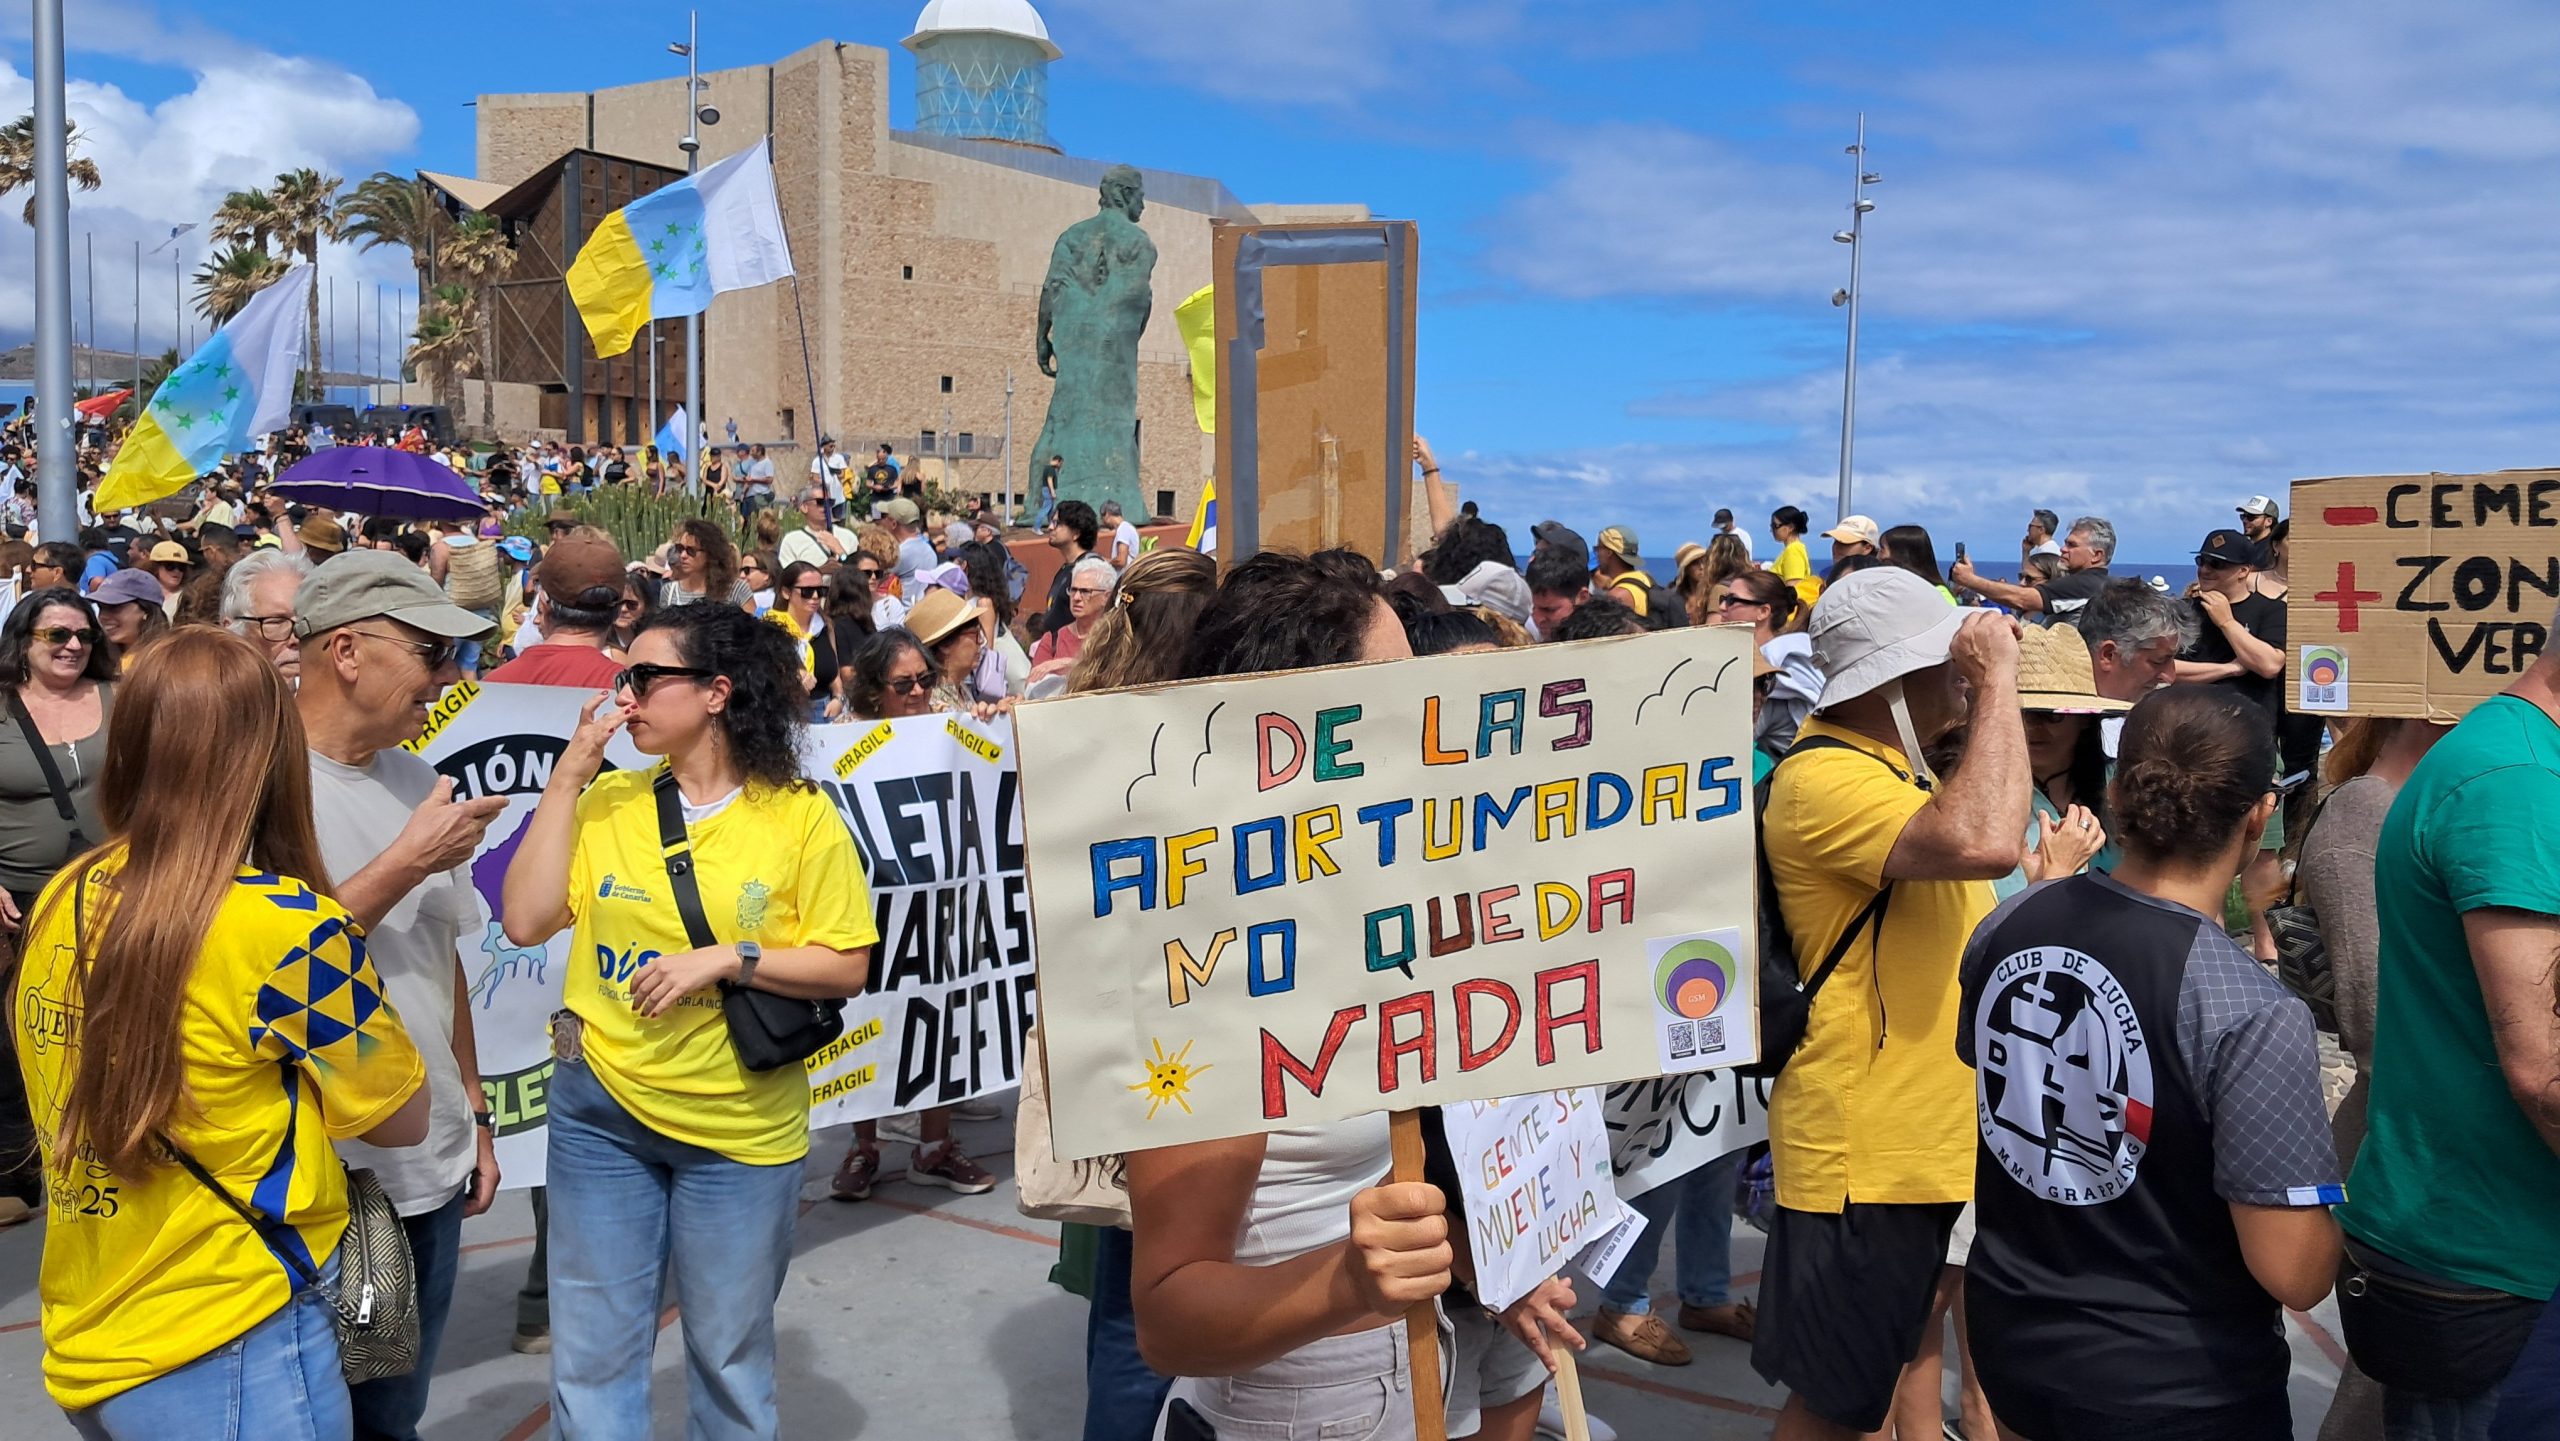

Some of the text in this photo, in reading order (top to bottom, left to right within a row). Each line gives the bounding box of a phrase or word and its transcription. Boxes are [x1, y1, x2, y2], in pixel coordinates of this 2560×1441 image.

[2396, 556, 2559, 612] ZON
[839, 732, 884, 773] FRAGIL
[947, 719, 985, 755] FRAGIL
[1257, 679, 1592, 791] DE LAS
[1164, 868, 1635, 1008] NO QUEDA
[1688, 993, 1706, 1003] GSM
[1996, 951, 2143, 1055] CLUB DE LUCHA
[818, 1023, 880, 1066] FRAGIL
[1260, 959, 1602, 1120] NADA
[812, 1068, 872, 1104] FRAGIL
[1482, 1104, 1549, 1191] GENTE
[1553, 1089, 1583, 1124] SE
[1979, 1102, 2140, 1201] BJJ MMA GRAPPLING
[80, 1185, 119, 1218] 25
[1477, 1140, 1582, 1266] MUEVE Y
[1538, 1190, 1598, 1266] LUCHA
